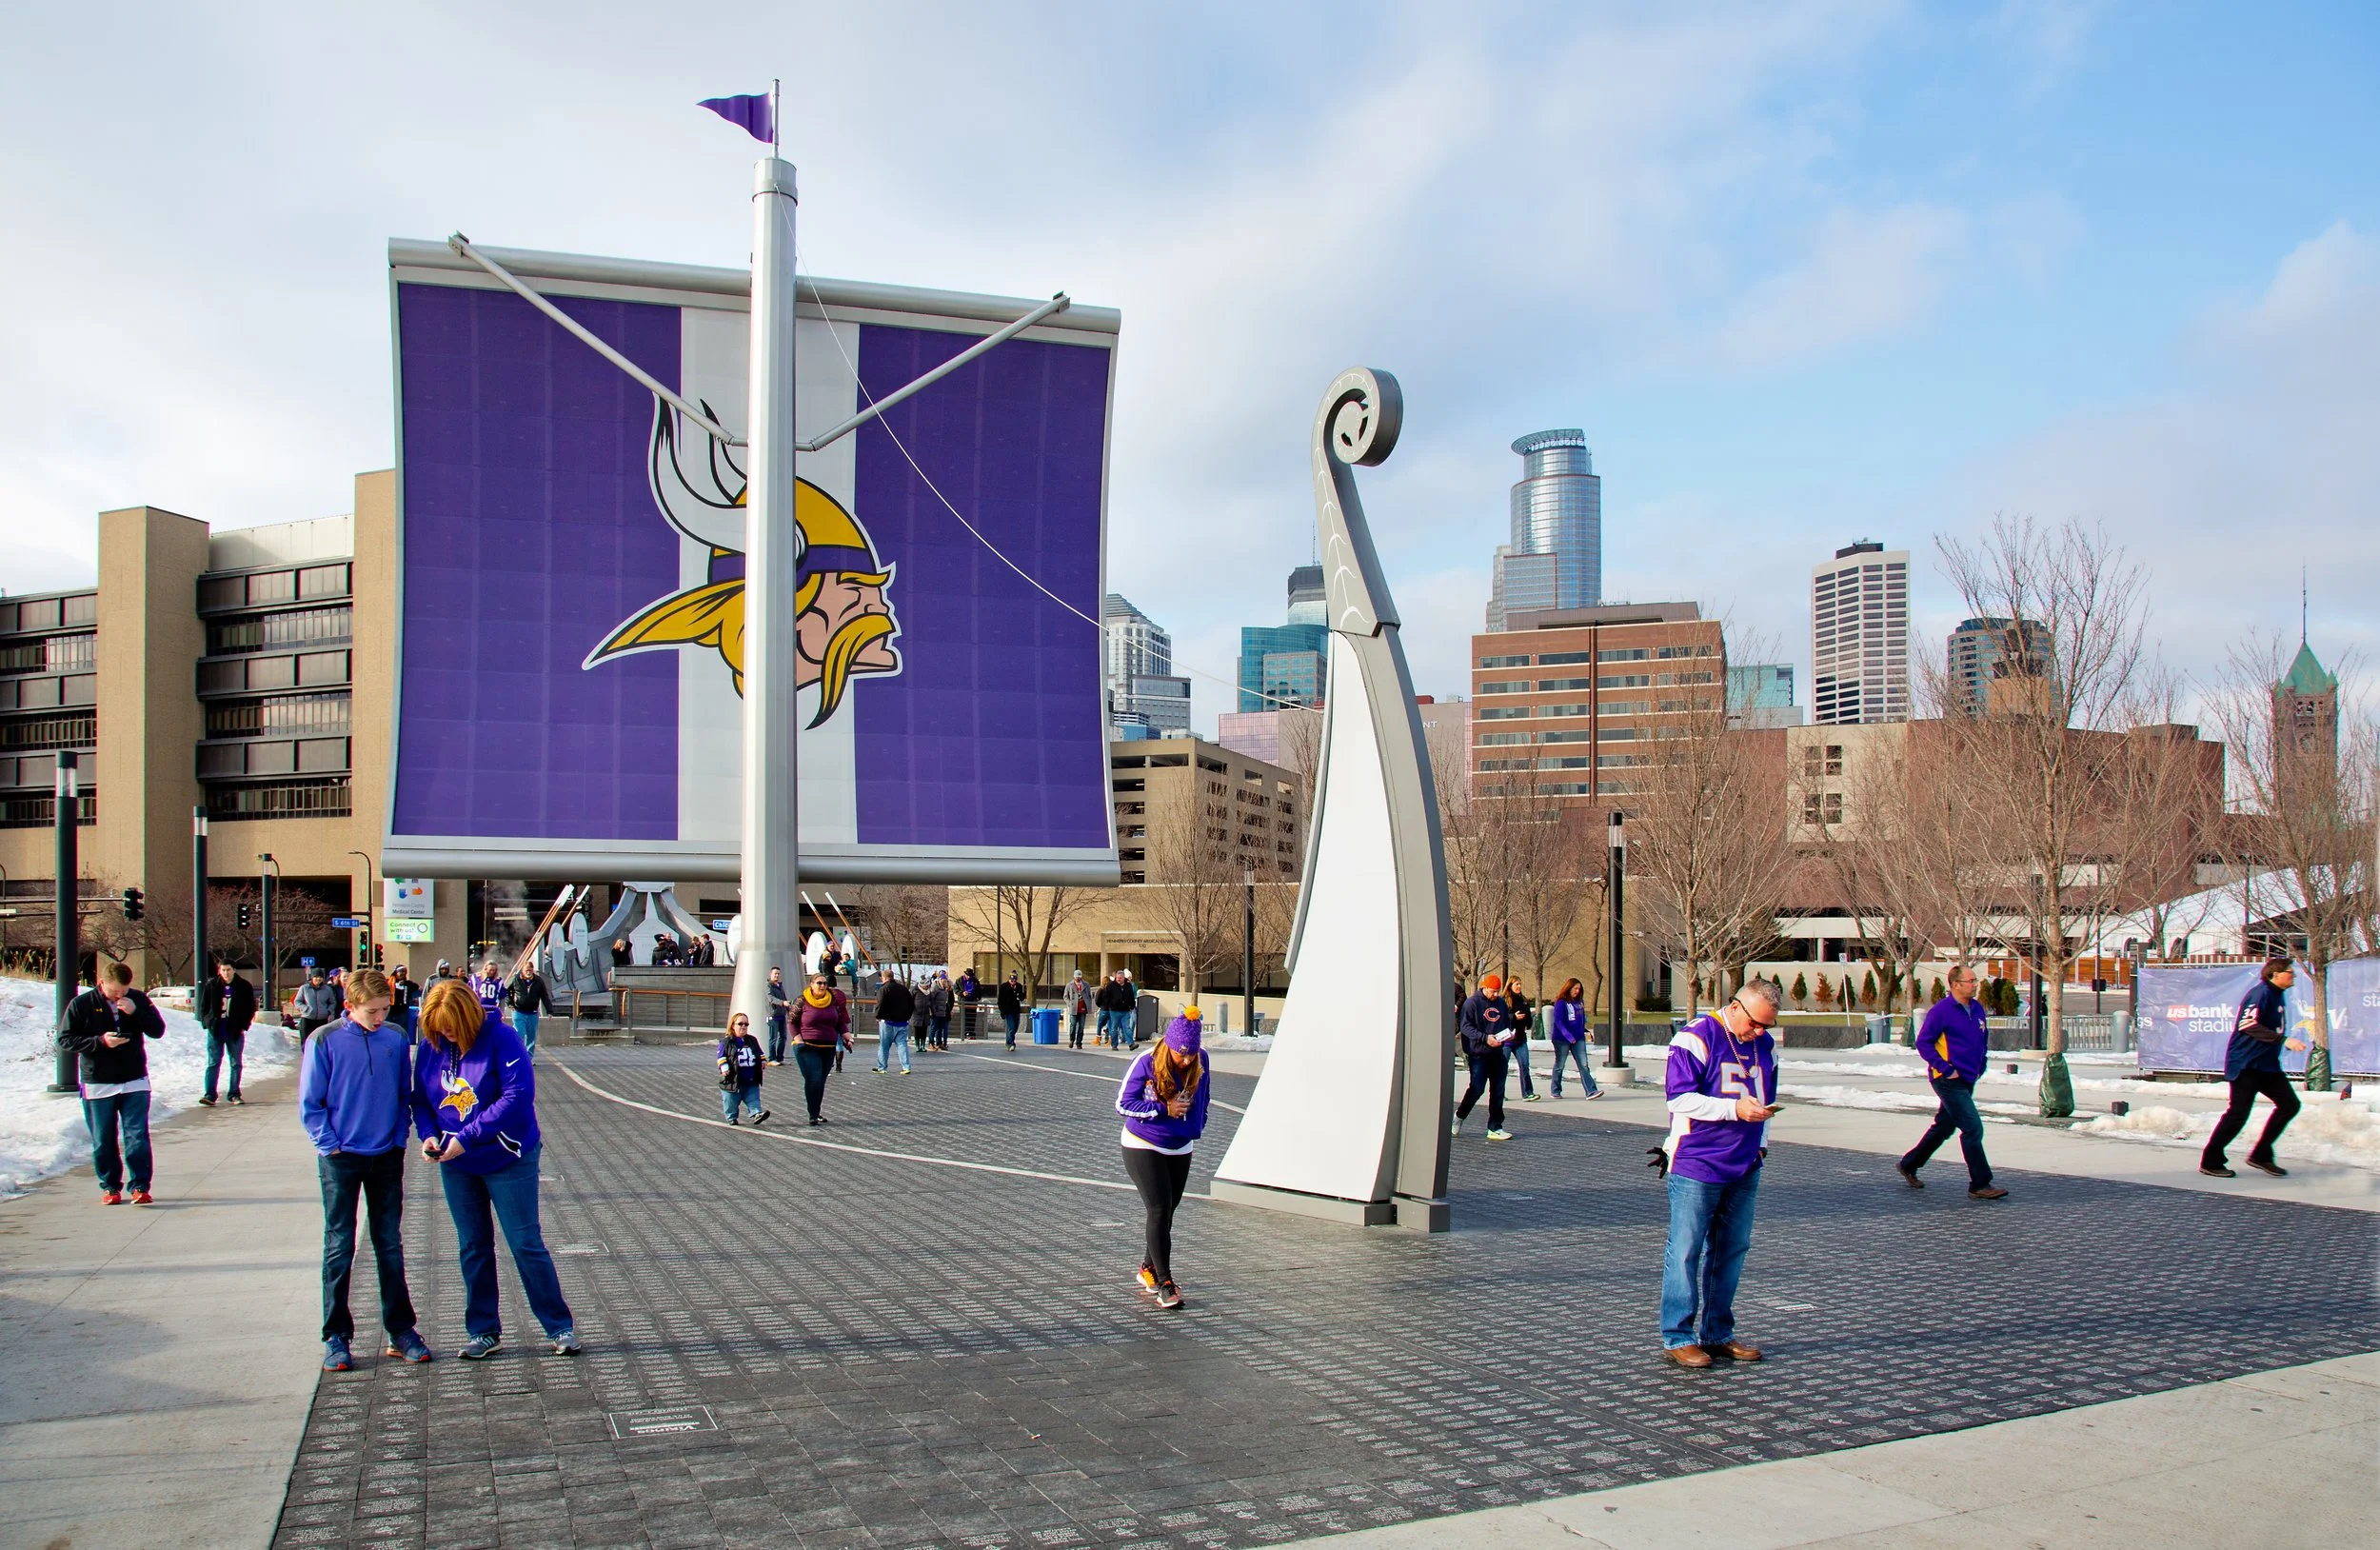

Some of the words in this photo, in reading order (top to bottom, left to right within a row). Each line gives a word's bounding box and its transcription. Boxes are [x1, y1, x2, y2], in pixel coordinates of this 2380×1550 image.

[479, 983, 496, 999] 40
[2243, 1009, 2257, 1020] 34
[1720, 1063, 1765, 1107] 51
